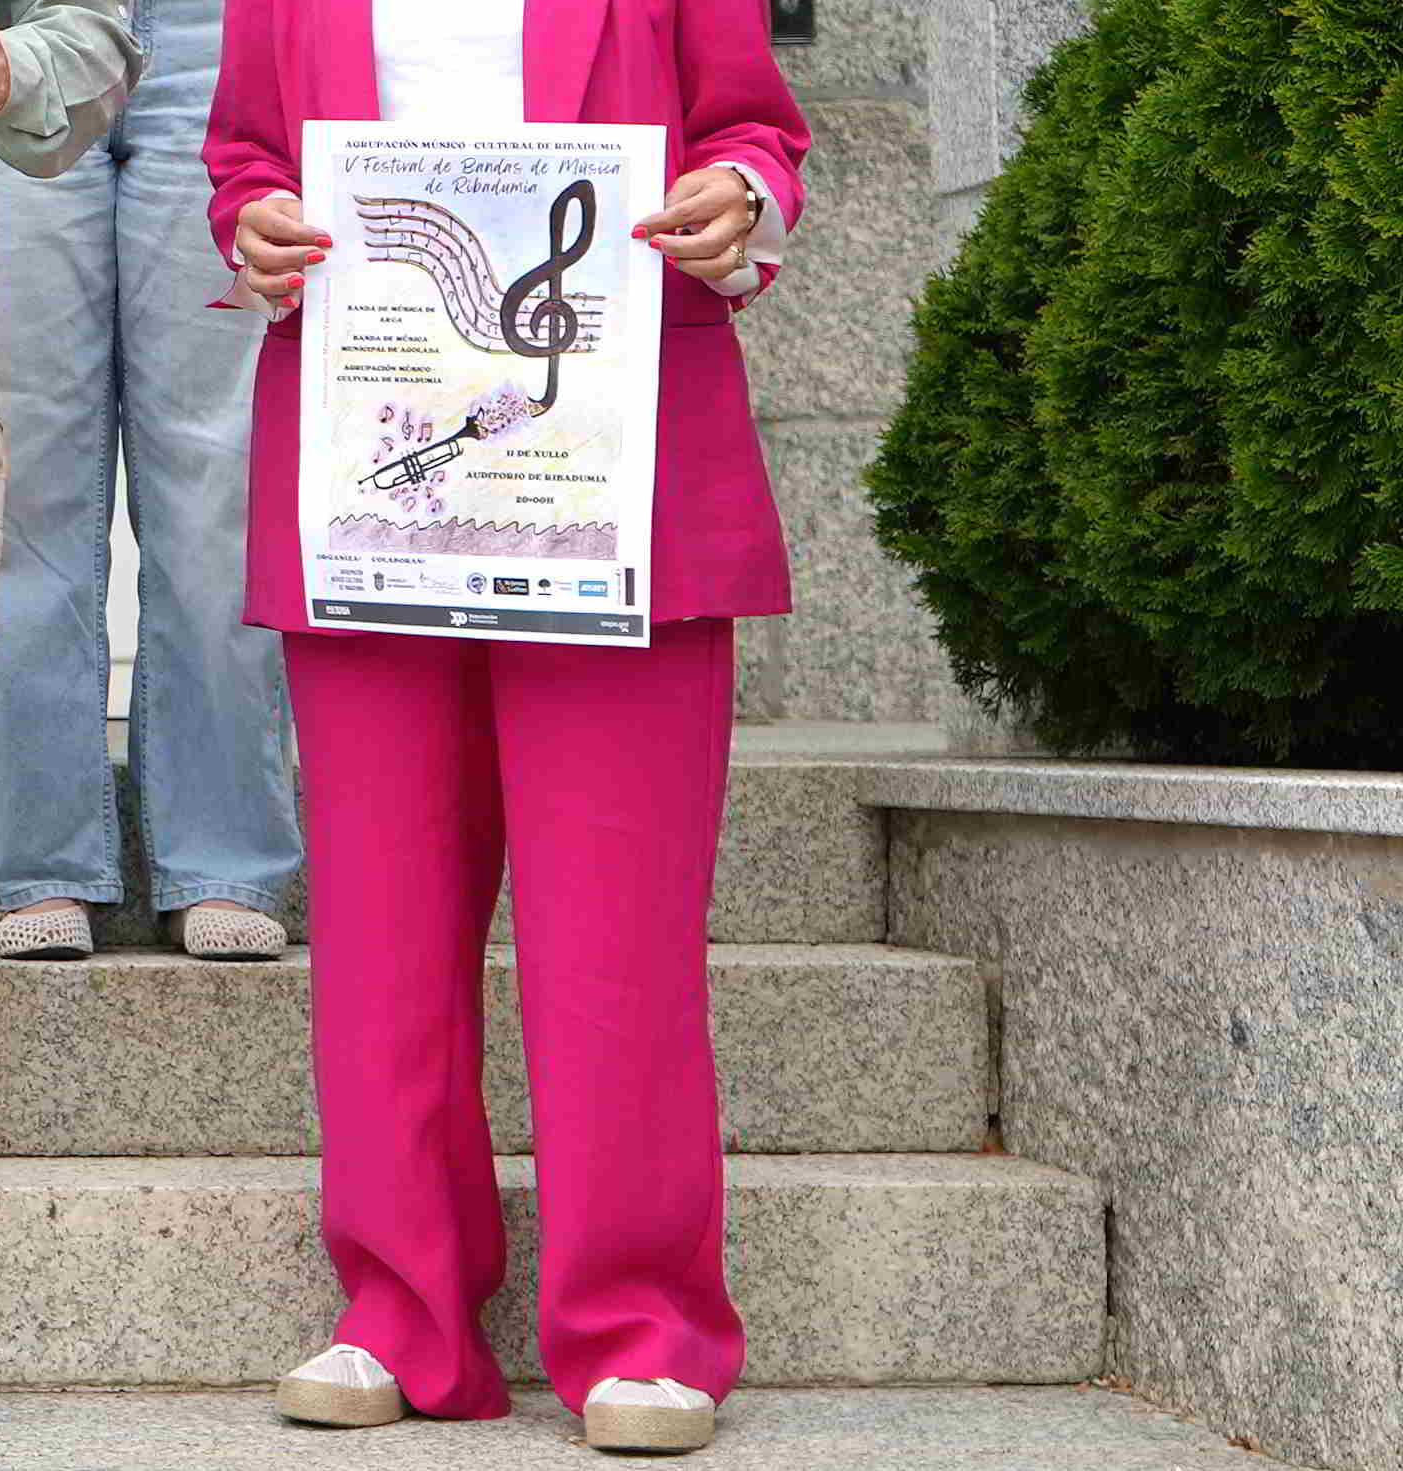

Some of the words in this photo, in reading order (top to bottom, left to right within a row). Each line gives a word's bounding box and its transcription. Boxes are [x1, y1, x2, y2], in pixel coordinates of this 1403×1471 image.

[346, 139, 418, 148] AGRUPACIÓN
[422, 138, 466, 149] MÚSICO
[474, 141, 534, 150] CULTURAL
[537, 142, 552, 150] DE
[345, 155, 359, 173] V
[363, 155, 426, 174] Festival
[433, 157, 452, 174] de
[460, 157, 523, 176] Bandas
[530, 158, 548, 176] de
[558, 158, 620, 176] Música
[425, 177, 443, 194] de
[452, 176, 538, 196] Ribadumia
[506, 449, 514, 457] 11
[517, 450, 531, 458] DE
[534, 450, 569, 459] XULLO
[465, 471, 526, 481] AUDITORIO
[528, 473, 542, 481] DE
[544, 473, 607, 483] RIBADUMIA
